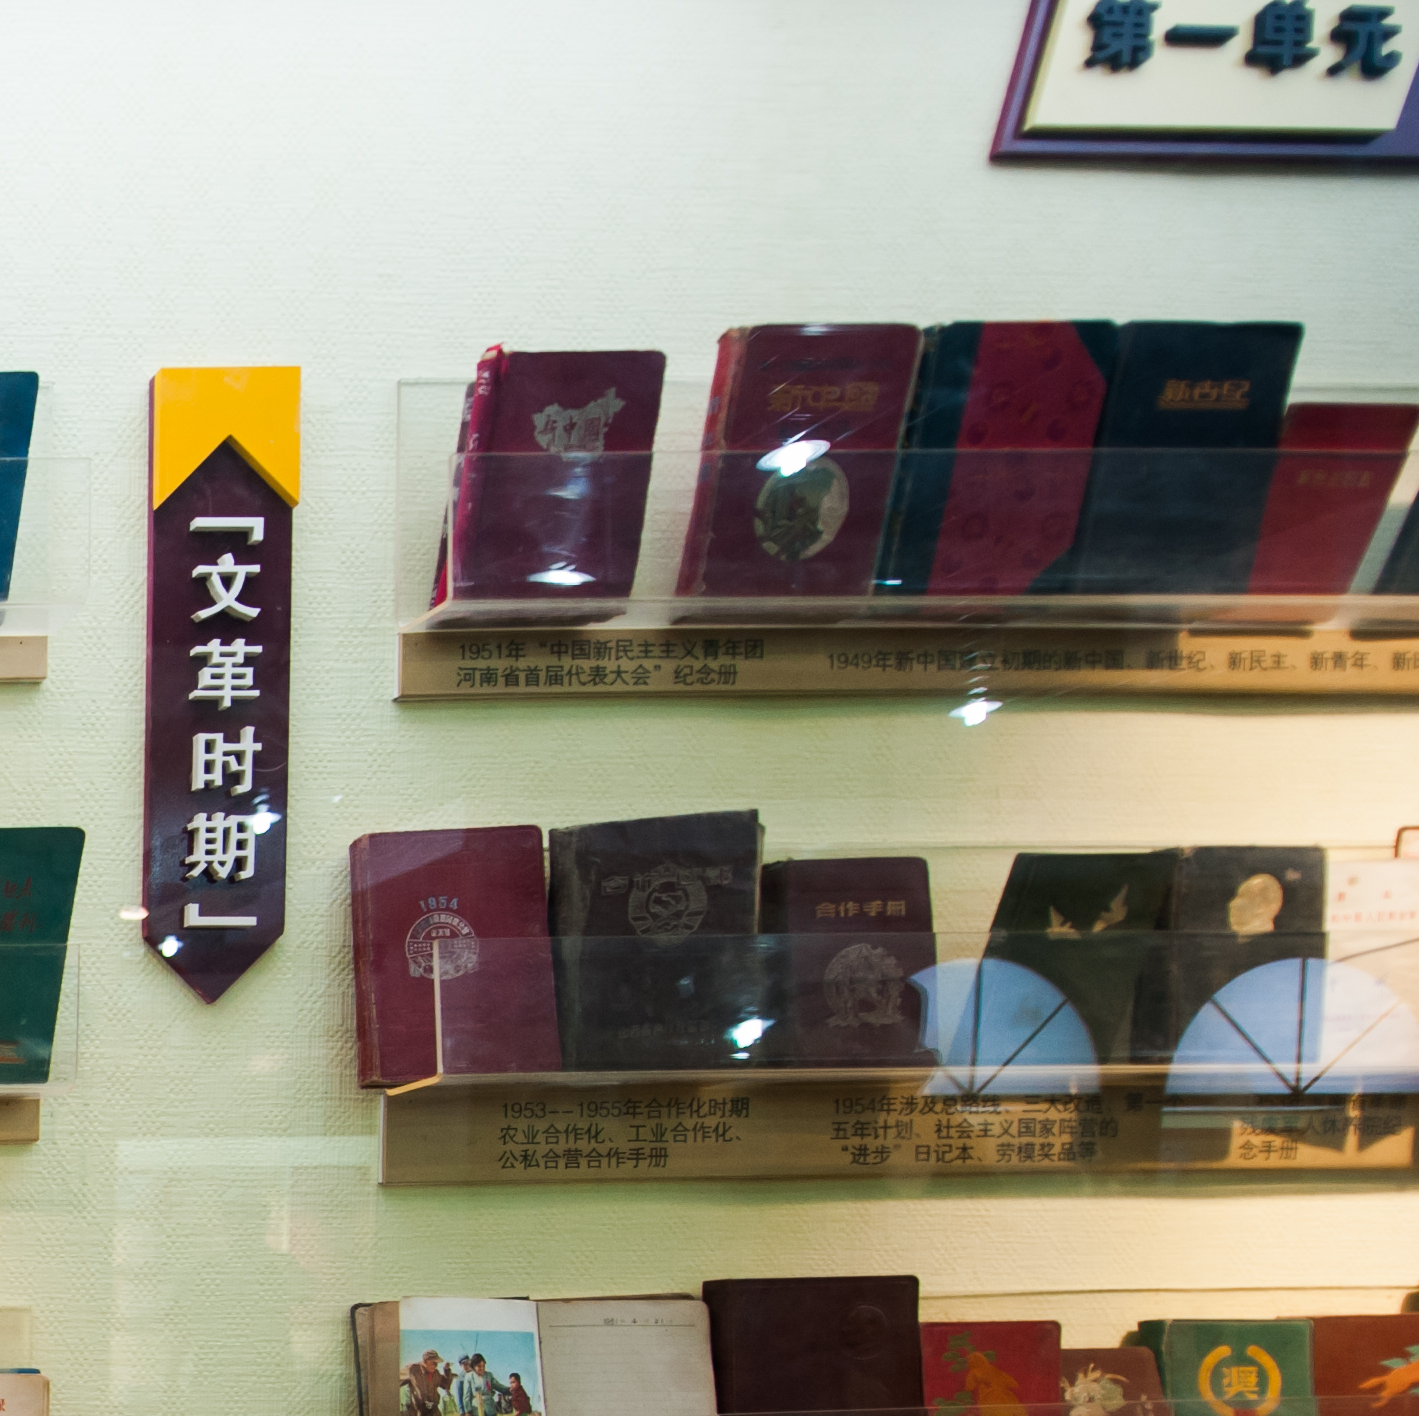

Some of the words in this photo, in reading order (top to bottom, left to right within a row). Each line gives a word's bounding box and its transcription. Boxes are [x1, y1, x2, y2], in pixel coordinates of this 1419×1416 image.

[1083, 0, 1404, 79] 第一单元
[418, 896, 459, 912] 1954
[815, 900, 906, 918] 合作手册
[498, 1147, 669, 1170] 公私合营合作手册
[1238, 1139, 1299, 1161] 念手册
